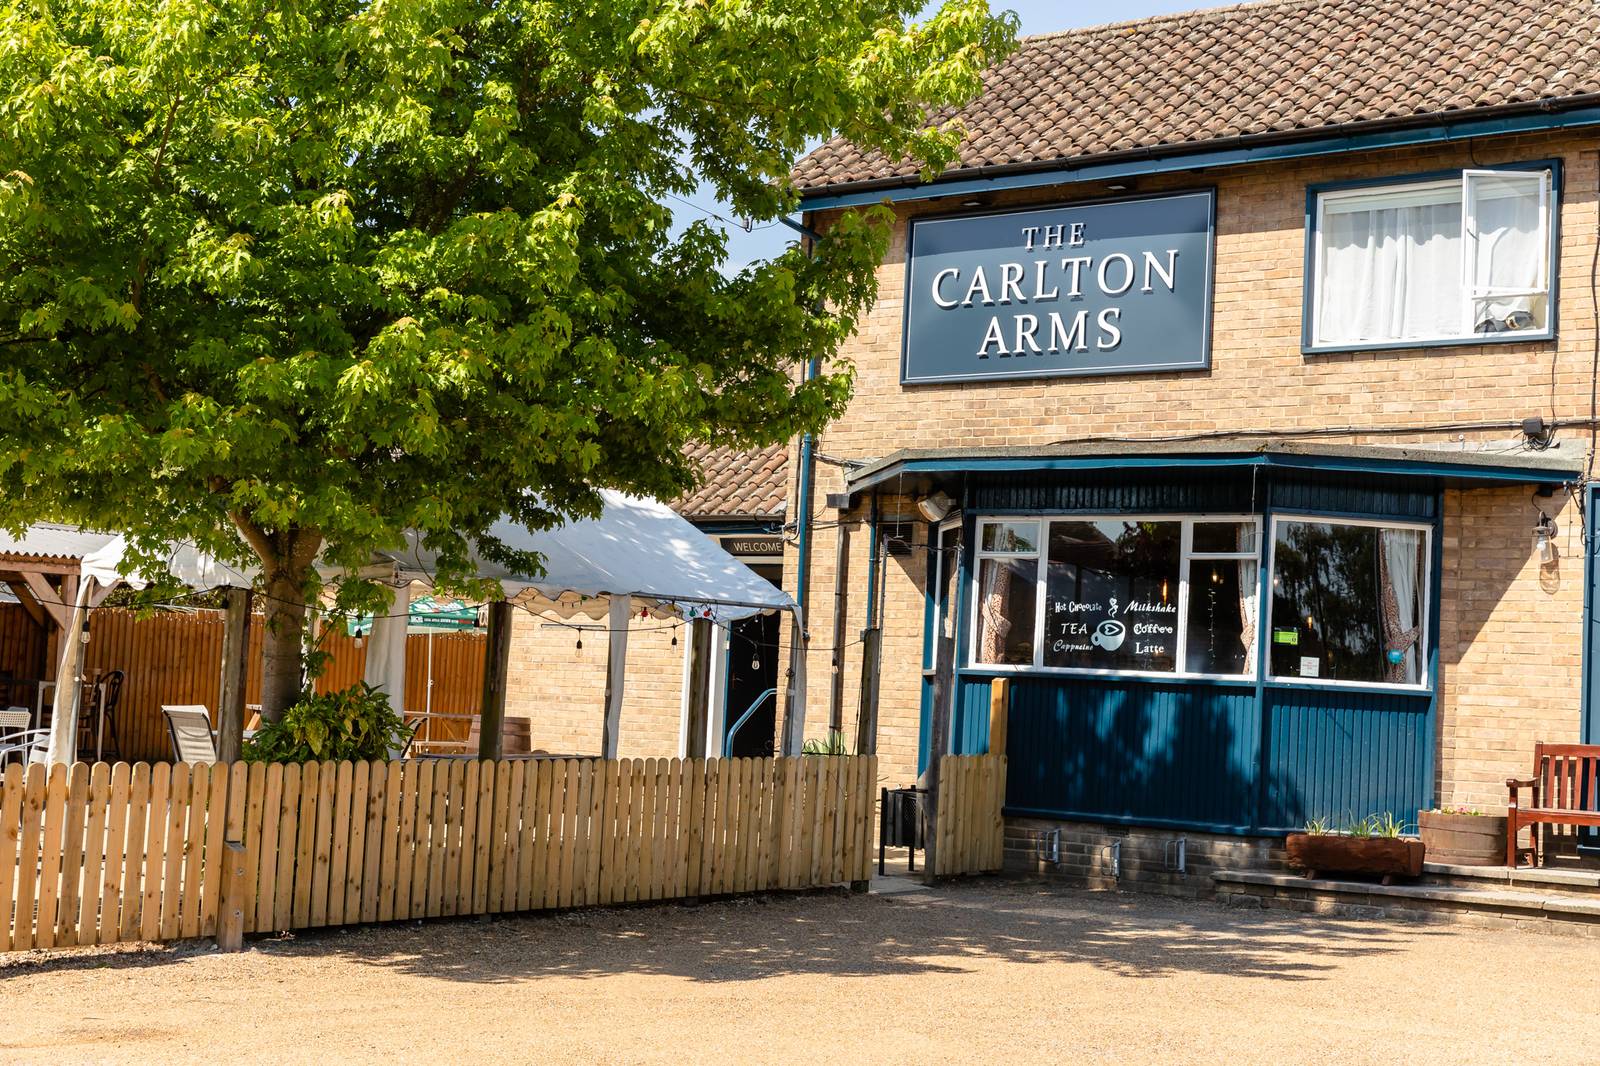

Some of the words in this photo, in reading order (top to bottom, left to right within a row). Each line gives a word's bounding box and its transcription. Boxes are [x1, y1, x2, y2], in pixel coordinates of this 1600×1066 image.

[1021, 222, 1085, 250] THE
[931, 250, 1178, 308] CARLTON
[976, 308, 1121, 356] ARMS
[733, 542, 783, 552] WELCOME
[1054, 601, 1067, 613] Hot
[1123, 600, 1177, 614] Milkshake
[1061, 623, 1088, 635] TEA
[1133, 623, 1173, 635] Coffee
[1135, 642, 1165, 654] Latte
